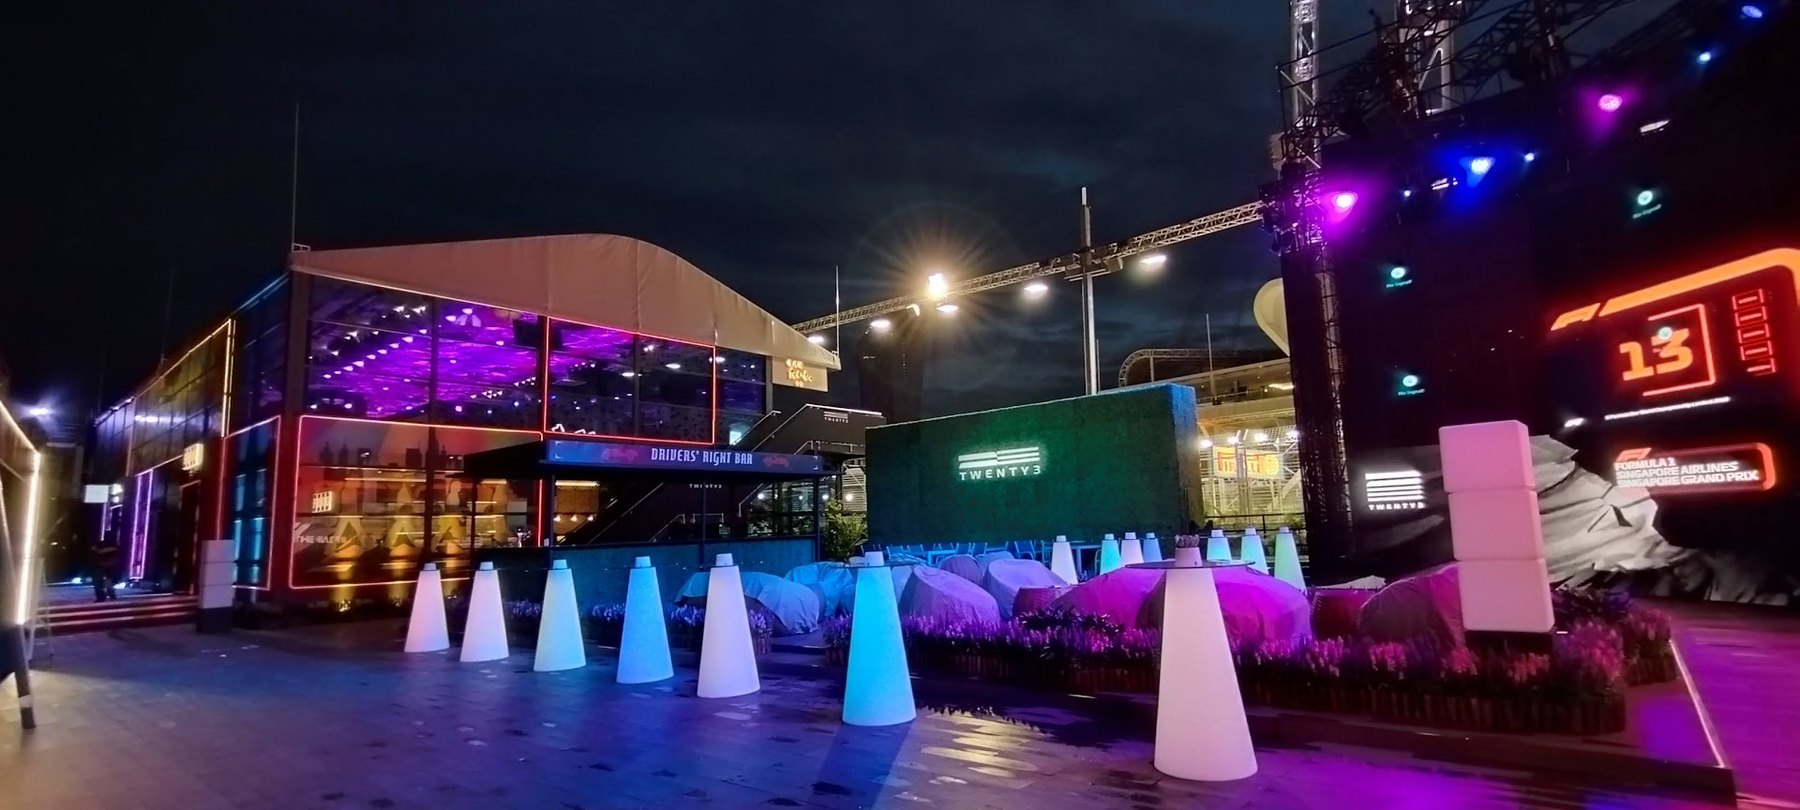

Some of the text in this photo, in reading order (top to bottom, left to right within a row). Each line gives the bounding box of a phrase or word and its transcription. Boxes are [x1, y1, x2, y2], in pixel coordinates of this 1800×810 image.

[1619, 328, 1693, 380] 13
[651, 448, 753, 466] DRIVERS' RIGHT BAR
[1614, 457, 1677, 471] FORMULA 1
[959, 465, 1040, 480] TWENTY3
[1616, 461, 1739, 479] SINGAPORE AIRLINES
[1617, 470, 1759, 488] SINGAPORE GRAND PRIX
